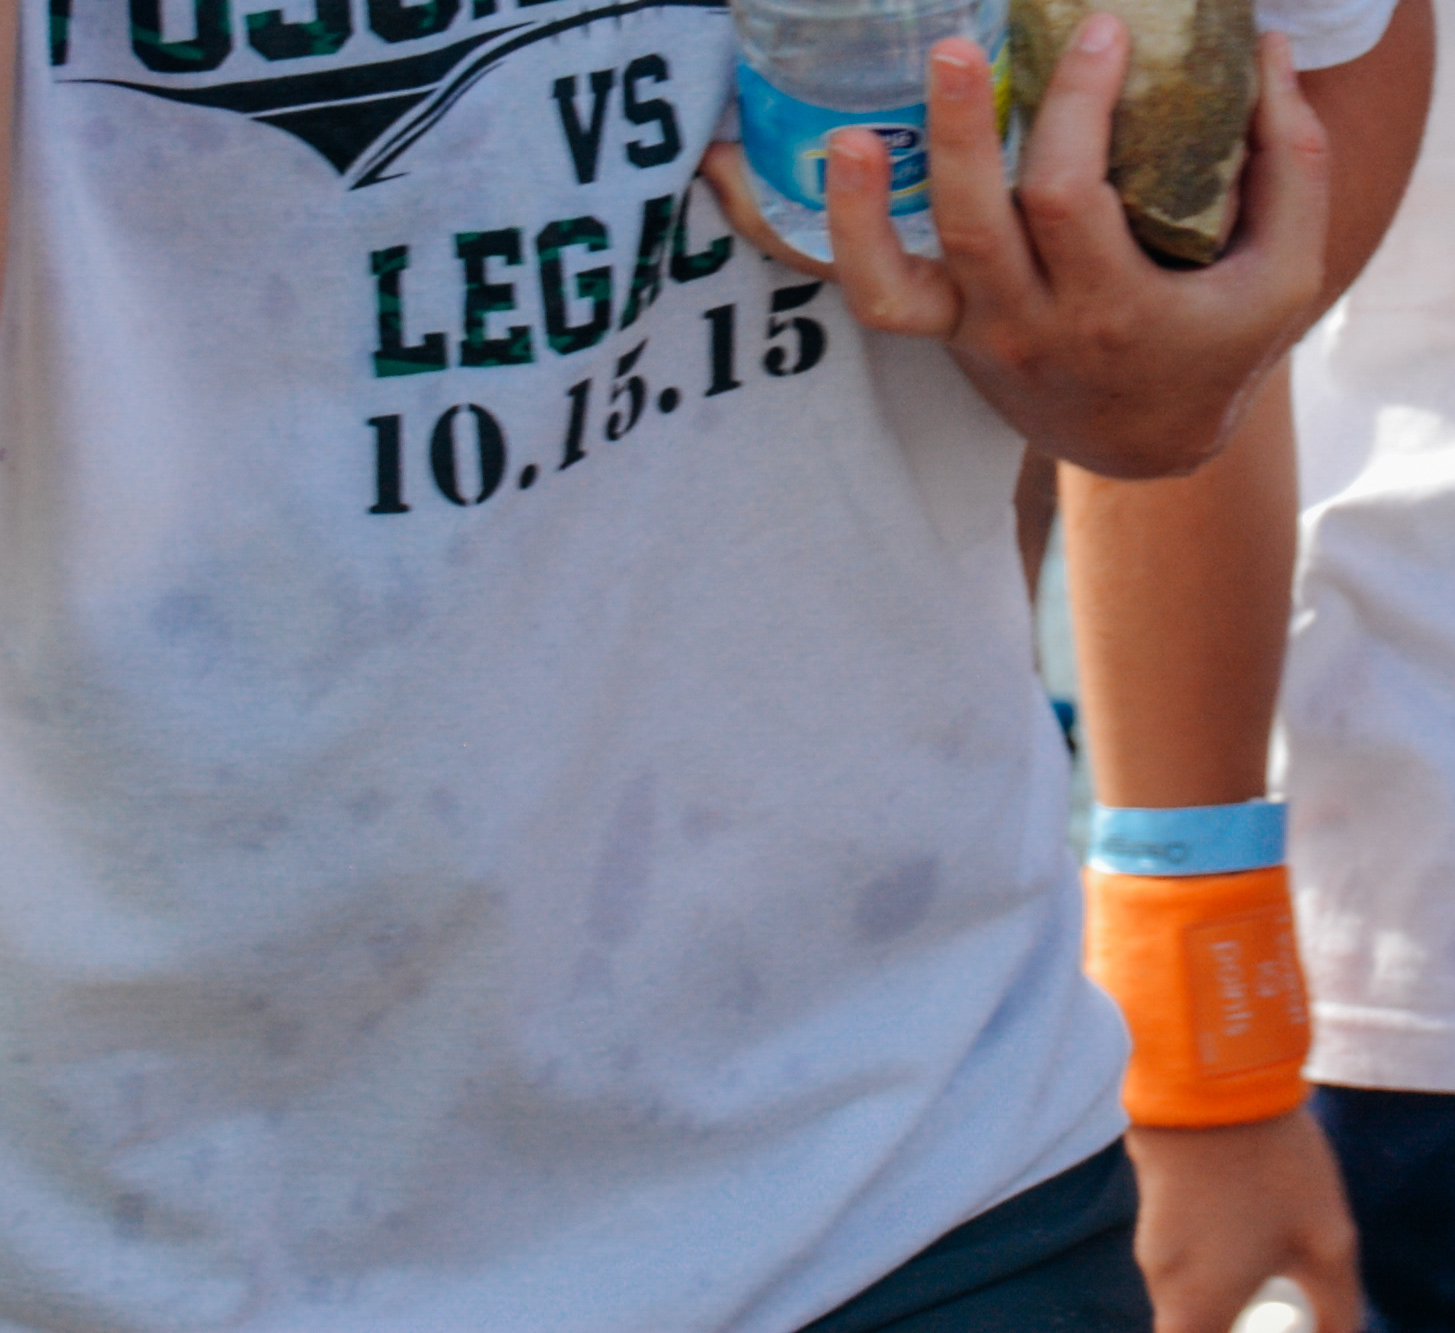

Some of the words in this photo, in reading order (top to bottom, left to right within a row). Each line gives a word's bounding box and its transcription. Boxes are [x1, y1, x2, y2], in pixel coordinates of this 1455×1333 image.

[553, 53, 682, 184] VS
[370, 185, 736, 378] LEGAC
[367, 281, 830, 515] 10.15.15
